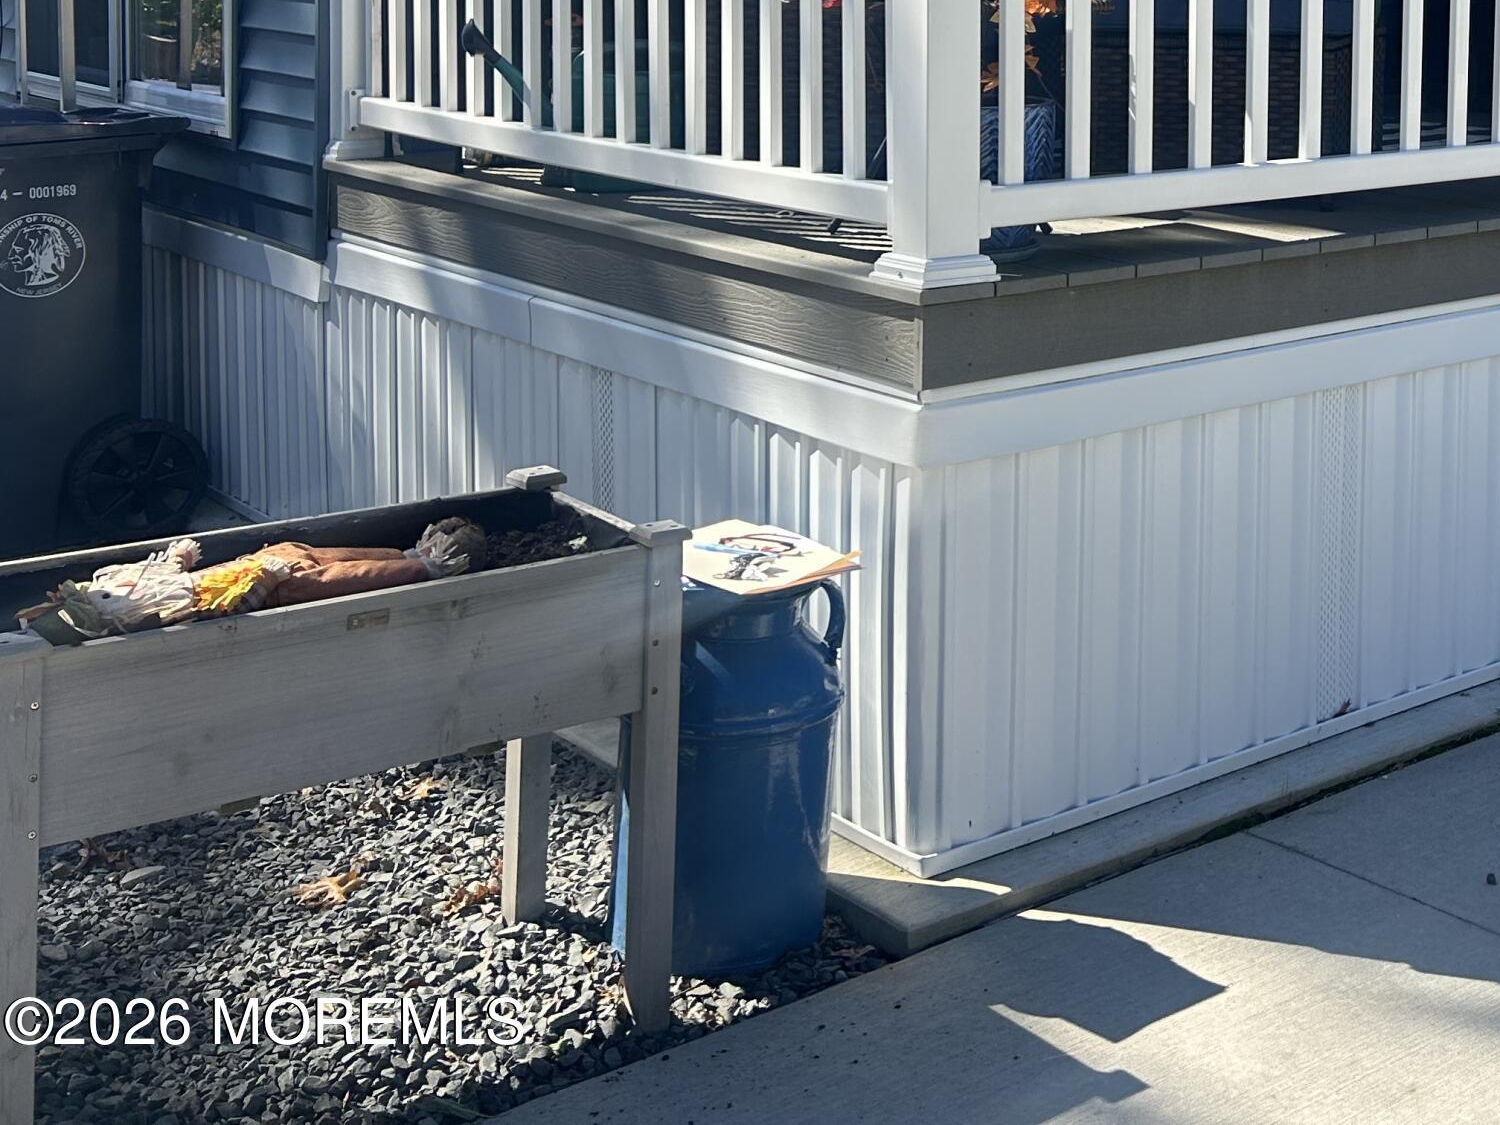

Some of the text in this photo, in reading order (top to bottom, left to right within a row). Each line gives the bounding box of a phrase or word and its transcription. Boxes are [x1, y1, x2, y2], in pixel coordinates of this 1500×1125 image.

[29, 184, 77, 199] 0001969
[25, 215, 39, 224] OF
[41, 215, 66, 228] TOMS
[65, 225, 83, 249] RIVER
